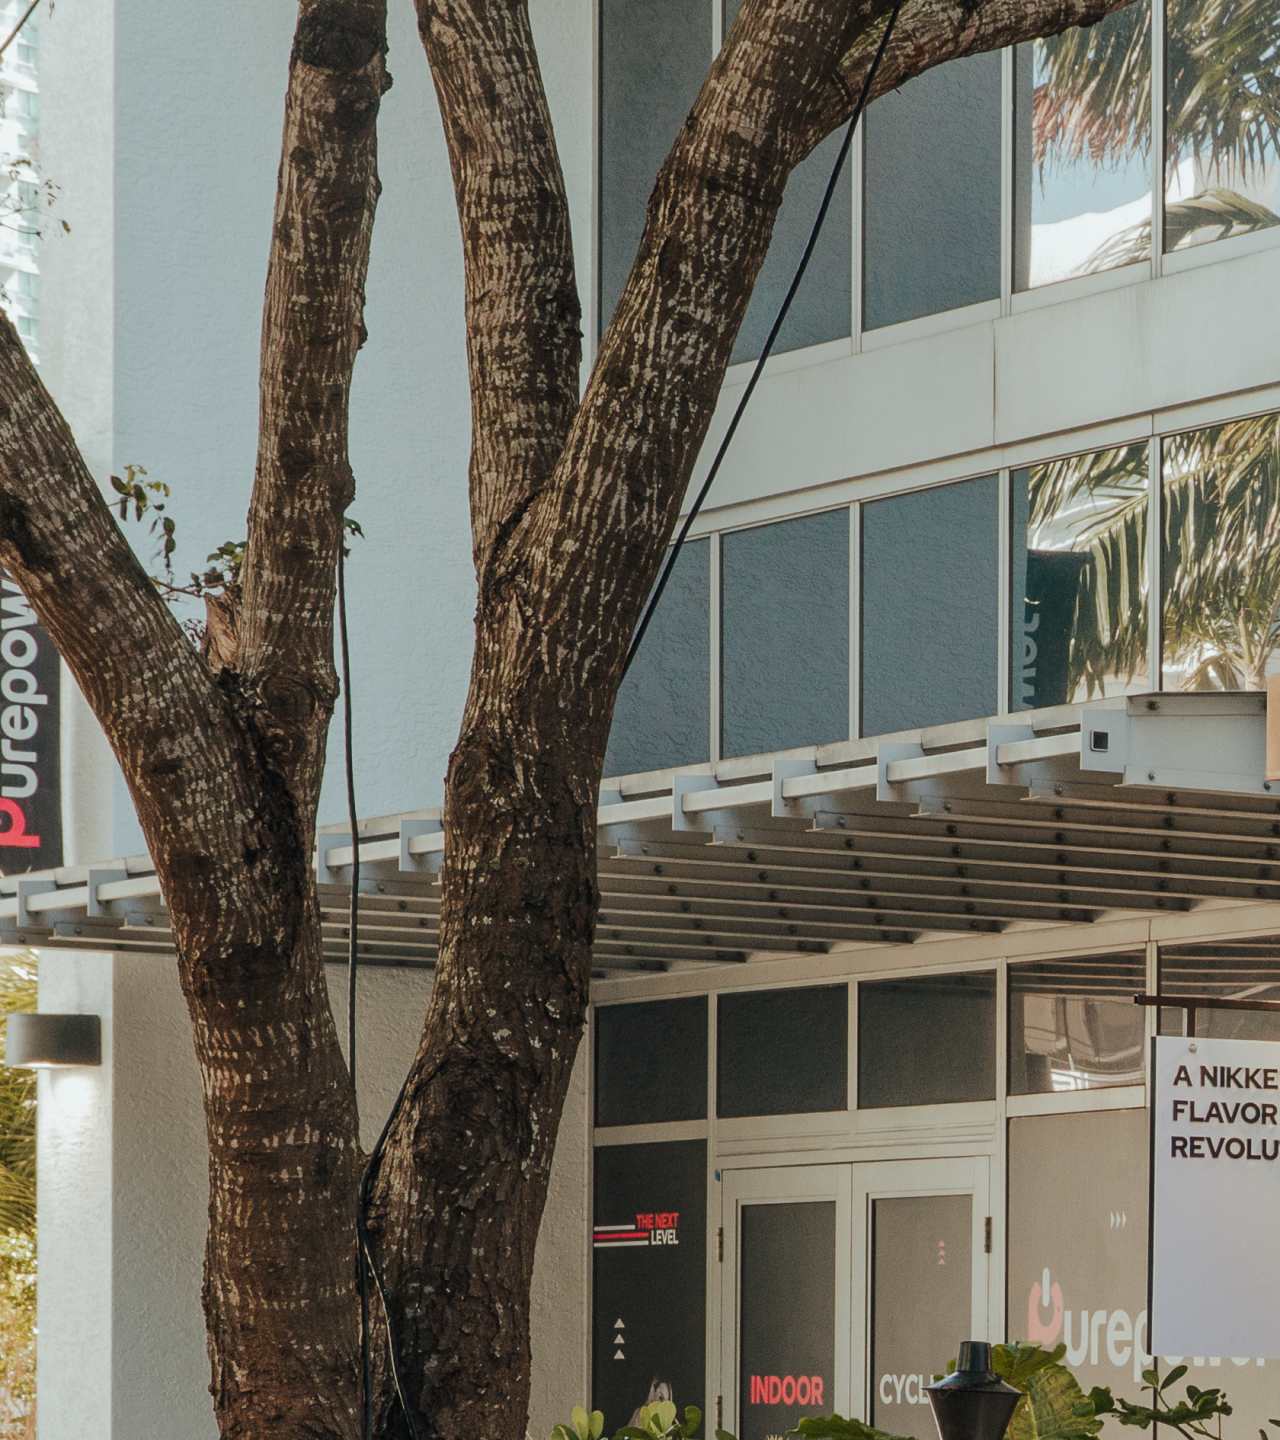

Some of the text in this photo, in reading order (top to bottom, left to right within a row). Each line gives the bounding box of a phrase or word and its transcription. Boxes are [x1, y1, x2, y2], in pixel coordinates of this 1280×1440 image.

[0, 568, 48, 848] purepow
[1172, 1065, 1193, 1088] A
[1171, 1100, 1278, 1125] FLAVOR
[636, 1212, 679, 1229] THE NEXT
[651, 1229, 679, 1245] LEVEL
[750, 1374, 935, 1406] INDOOR CYCL
